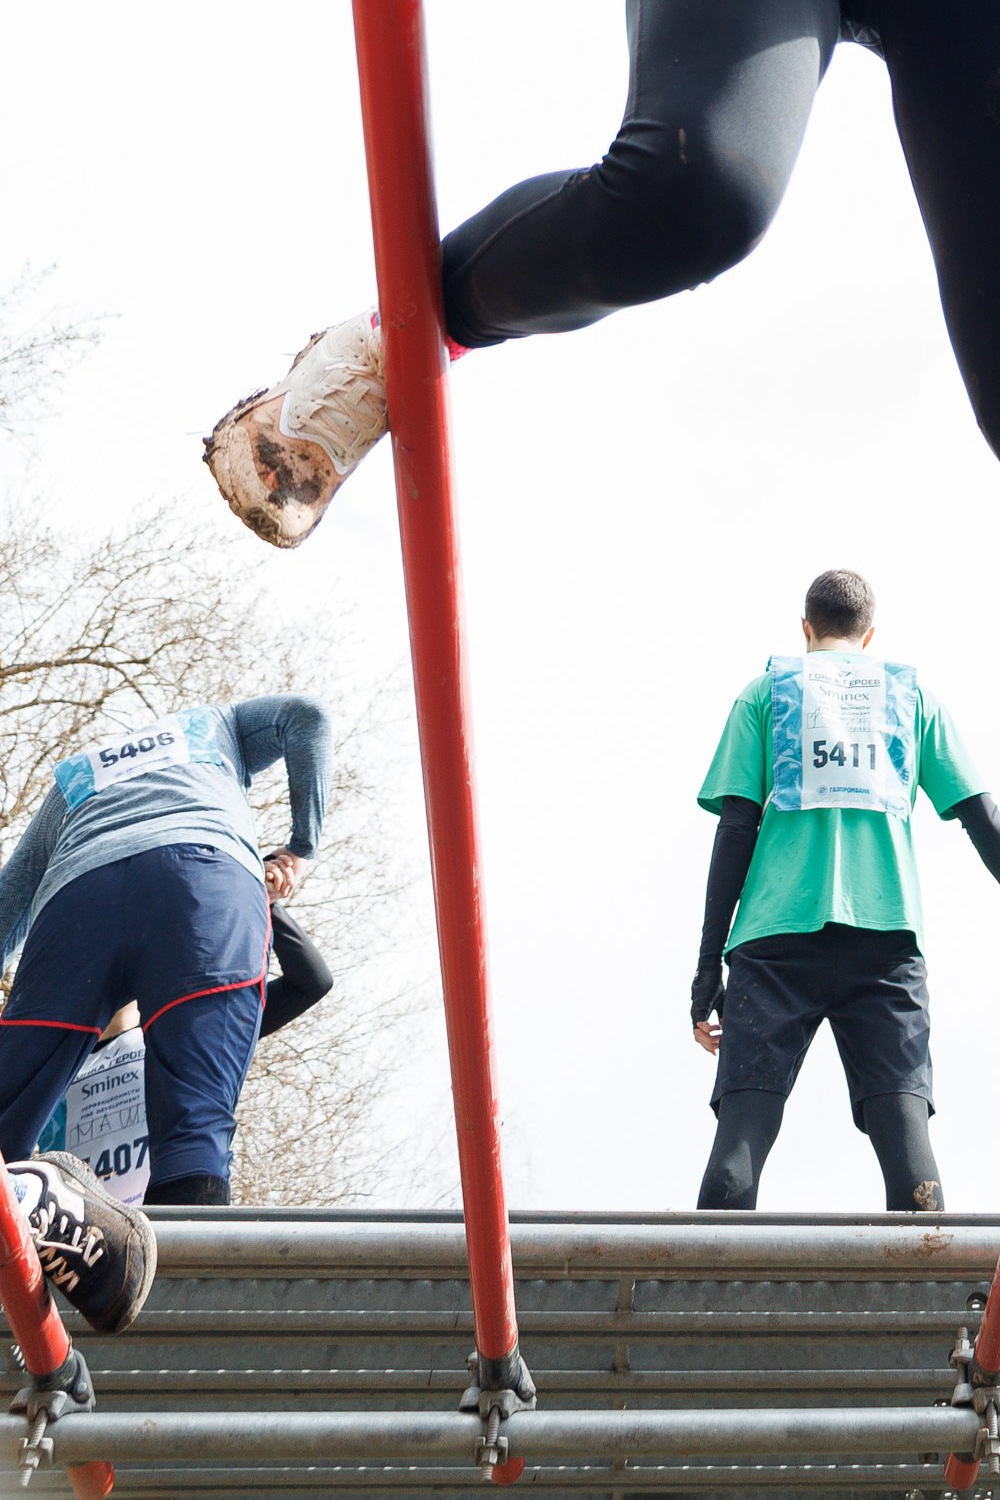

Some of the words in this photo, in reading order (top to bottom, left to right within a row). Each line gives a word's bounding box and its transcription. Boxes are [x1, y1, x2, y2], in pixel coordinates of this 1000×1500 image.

[98, 731, 175, 768] 5406
[813, 740, 876, 771] 5411
[109, 1048, 145, 1067] ГЕРОЕ
[81, 1068, 140, 1100] Sminex
[76, 1103, 145, 1145] МАШ
[82, 1135, 149, 1182] 407
